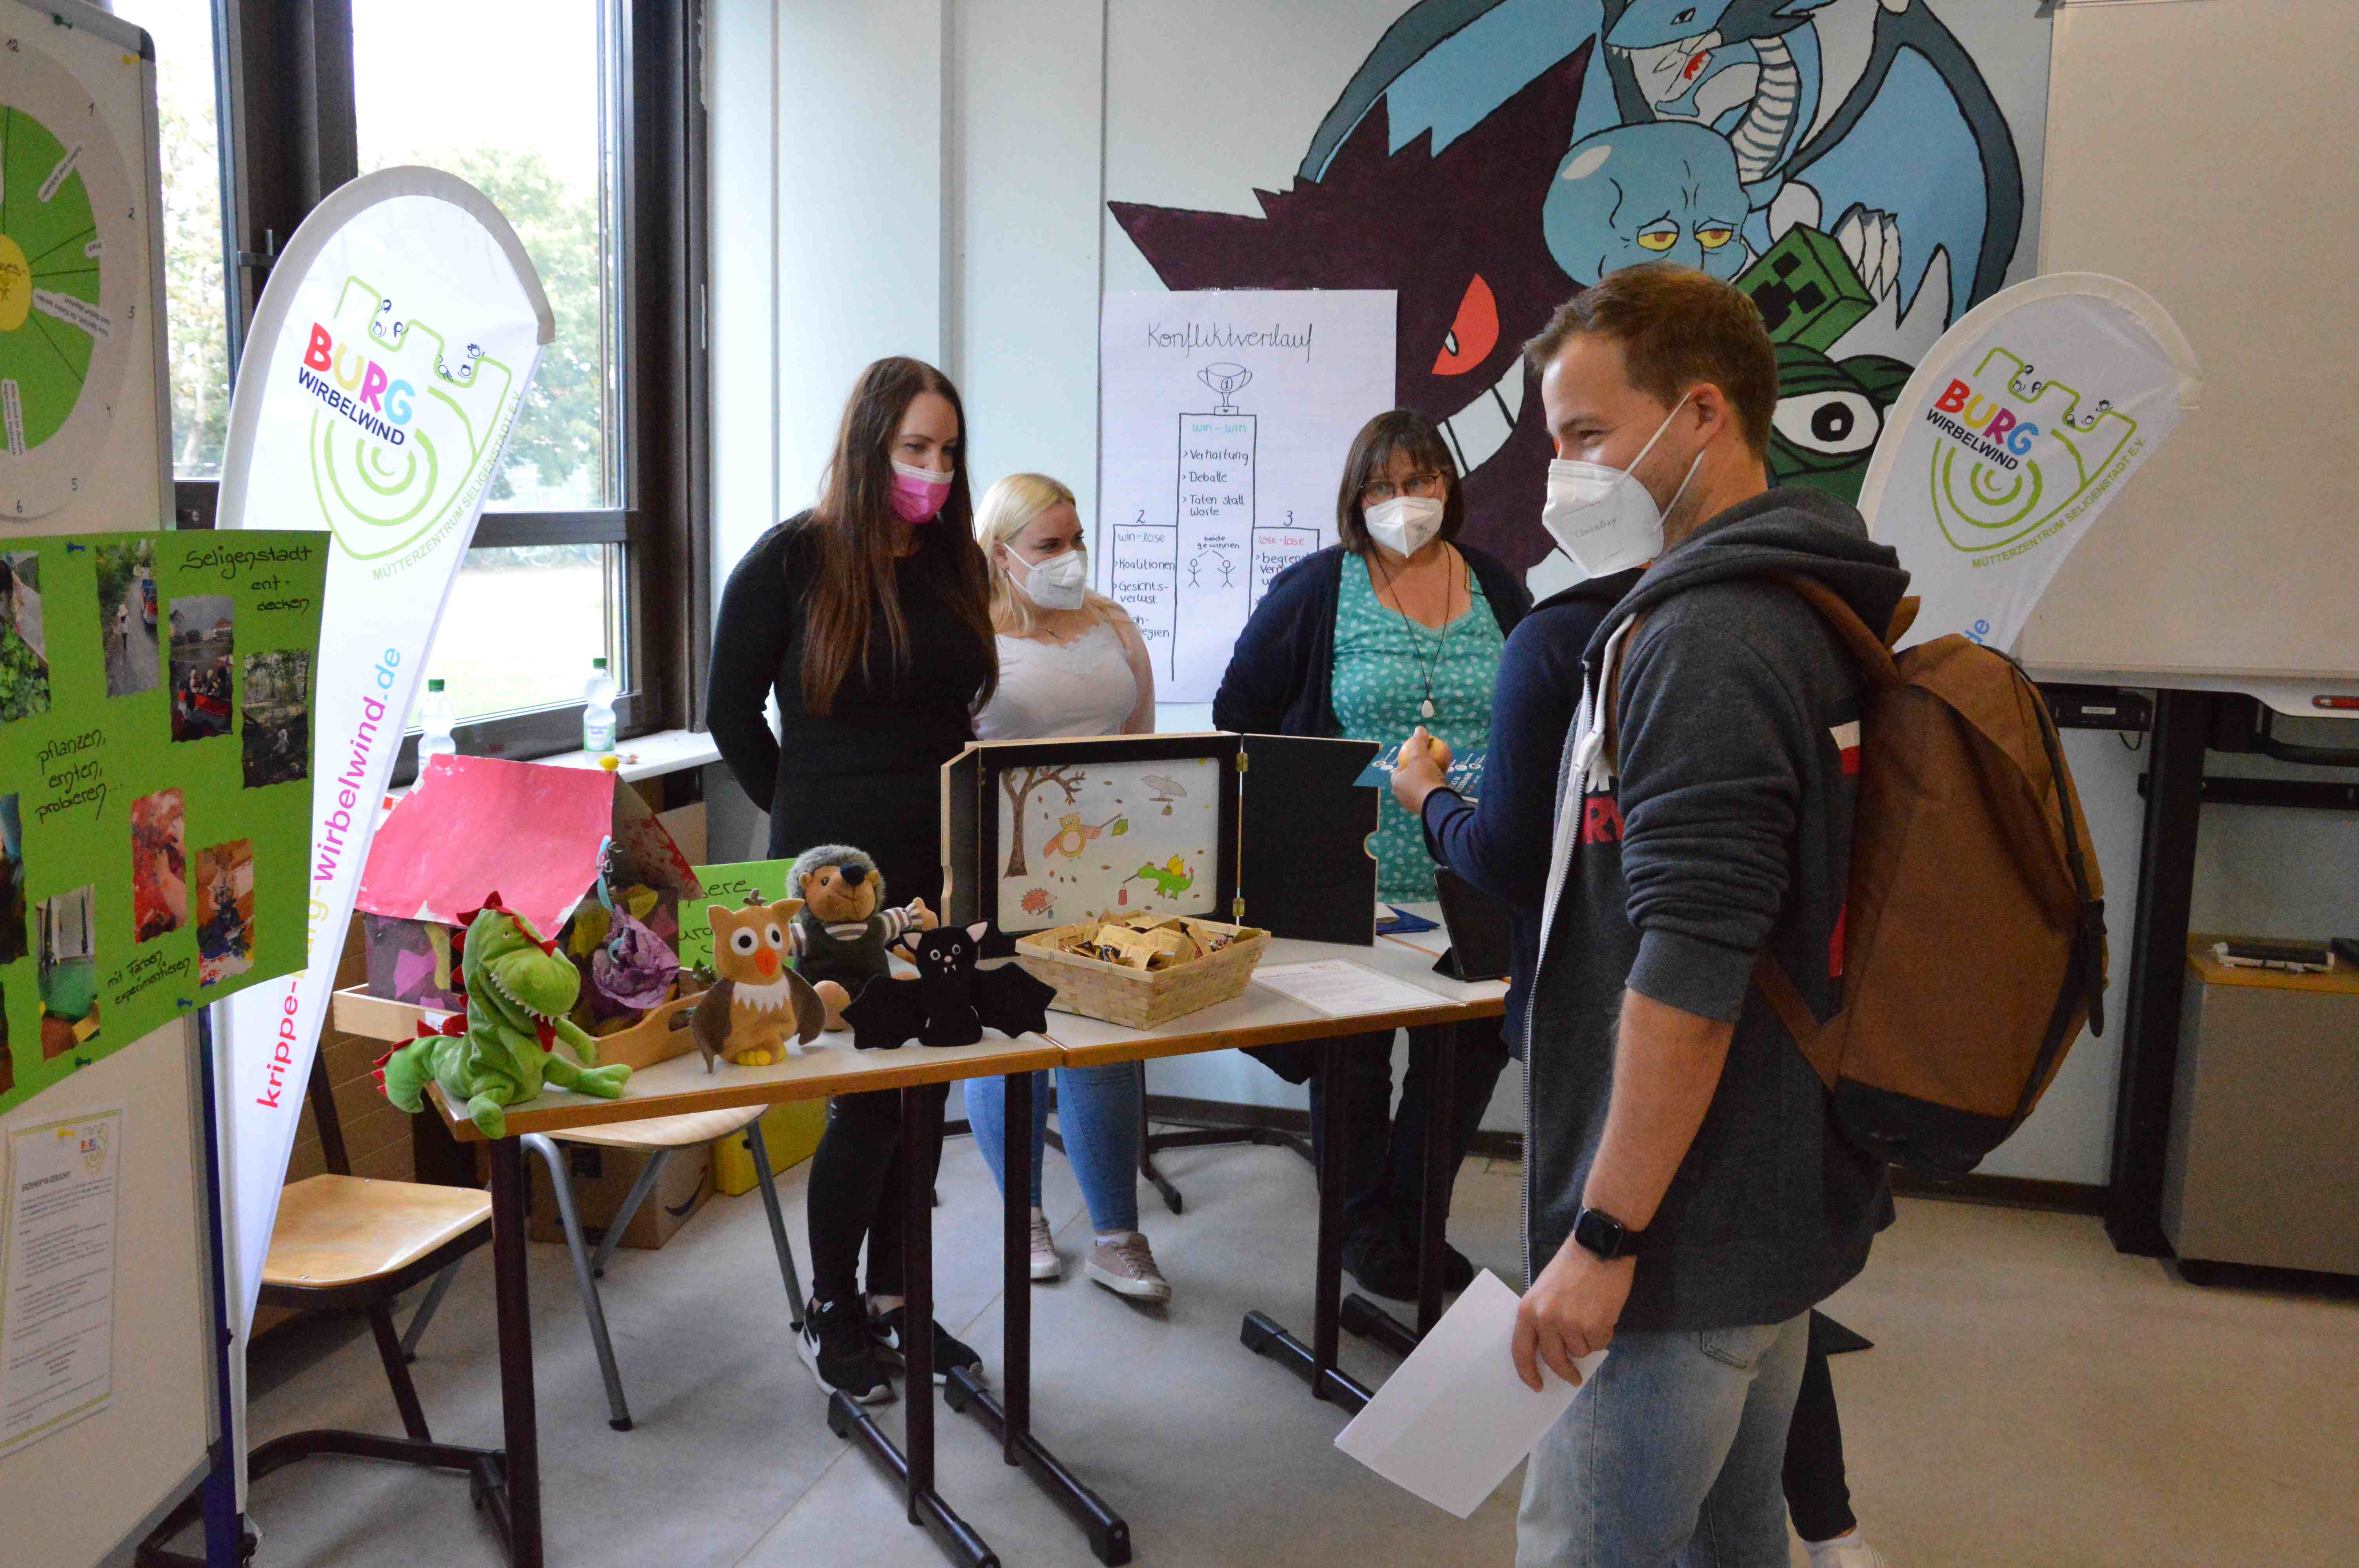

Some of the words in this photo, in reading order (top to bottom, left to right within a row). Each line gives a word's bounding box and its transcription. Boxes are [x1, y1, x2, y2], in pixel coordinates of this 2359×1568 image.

[128, 207, 134, 220] 2
[127, 306, 134, 319] 3
[1147, 323, 1313, 363] Konfliktverlauf
[303, 322, 415, 425] BURG
[298, 367, 405, 445] WIRBELWIND
[1934, 378, 2039, 456] BURG
[1193, 424, 1212, 432] win
[1225, 423, 1247, 433] win
[1926, 409, 2018, 470] WIRBELWIND
[1189, 470, 1227, 483] Debatte
[2065, 456, 2130, 522] SELIGENSTADT
[1190, 494, 1217, 505] Taten
[1223, 494, 1245, 505] statt
[1136, 510, 1145, 524] 2
[1190, 507, 1219, 517] Worte
[1283, 510, 1293, 526] 3
[372, 506, 464, 580] MÜTTERZENTRUM
[180, 545, 312, 579] Seligenstadt
[1119, 559, 1176, 571] Koalitionen
[257, 598, 309, 615] decken
[1120, 593, 1156, 604] verlust
[1141, 628, 1170, 641] egien
[37, 730, 105, 775] pflanzen,
[126, 951, 162, 976] Farben
[107, 970, 123, 989] mit
[115, 957, 191, 1004] experimentieren
